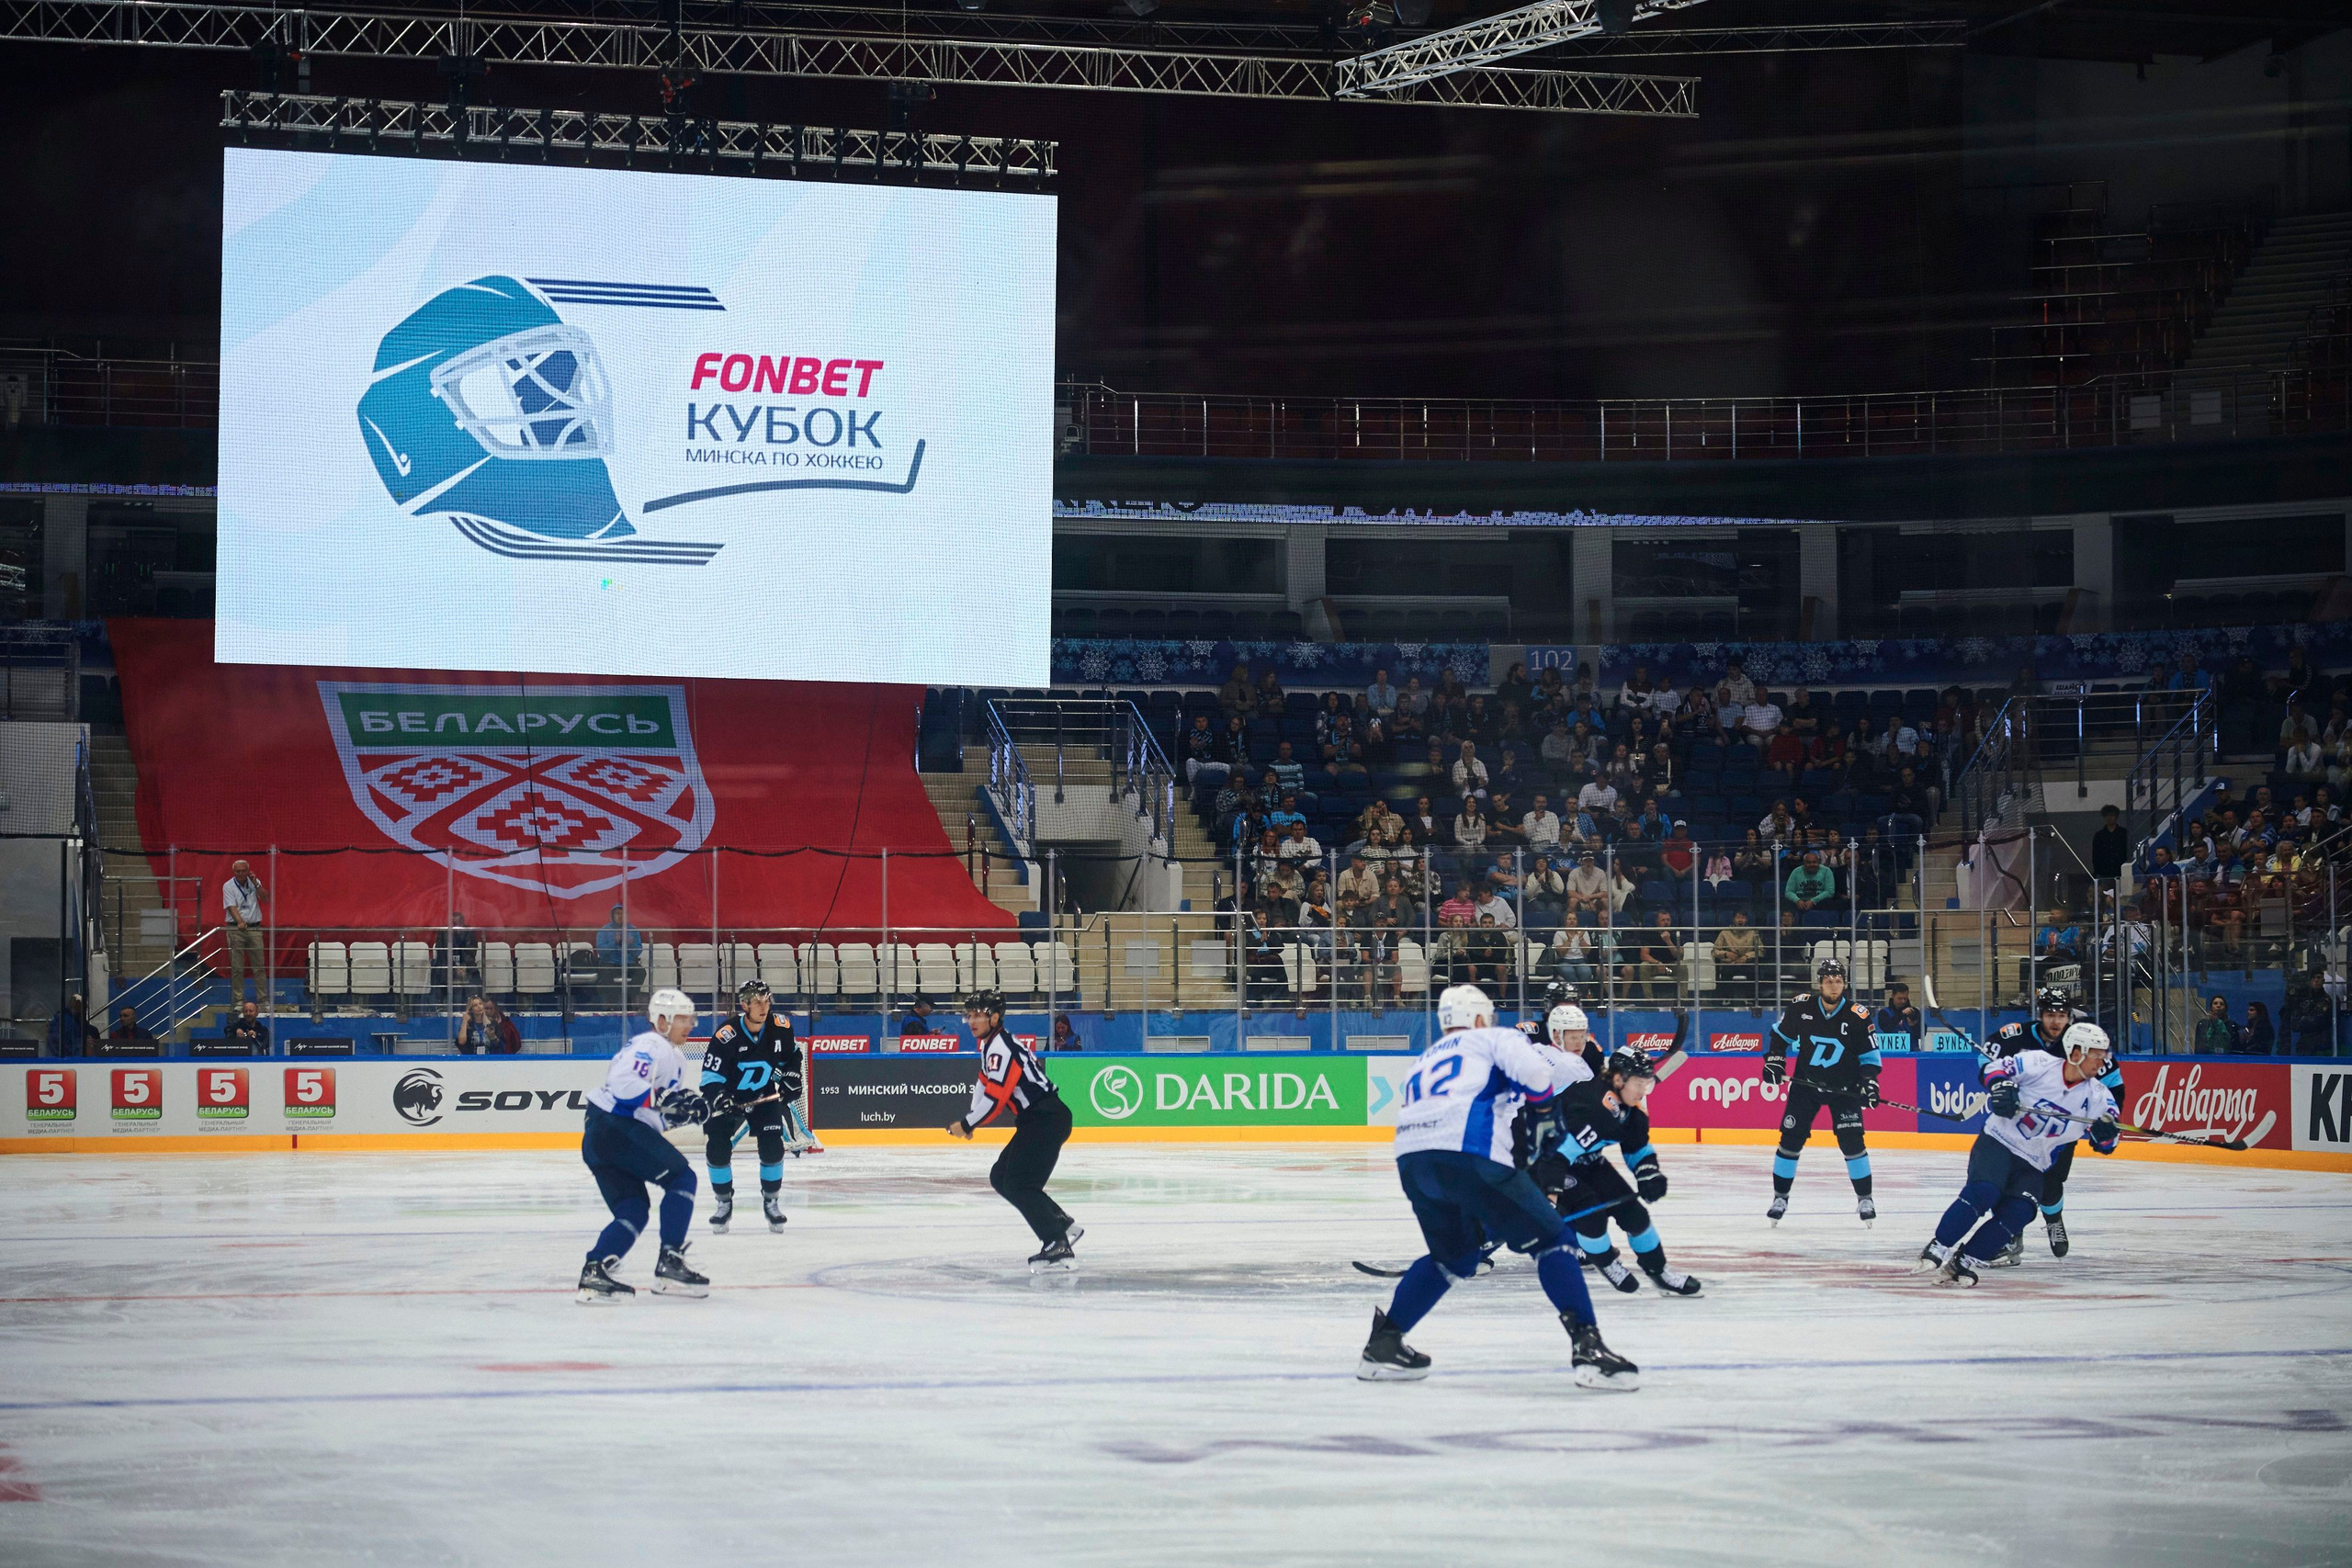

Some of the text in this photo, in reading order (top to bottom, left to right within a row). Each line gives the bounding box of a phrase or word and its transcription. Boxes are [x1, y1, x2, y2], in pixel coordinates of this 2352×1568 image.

[690, 353, 884, 398] FONBET
[687, 402, 883, 448] КУБОК
[685, 448, 883, 470] МИНСКА ПО ХОККЕЮ
[1531, 650, 1573, 671] 102
[359, 710, 660, 735] БЕЛАРУСЬ
[1840, 1021, 1849, 1035] C
[774, 1040, 782, 1053] A
[811, 1039, 867, 1051] FONBET
[901, 1038, 957, 1050] FONBET
[1880, 1036, 1906, 1050] YNEX
[704, 1053, 722, 1072] 33
[39, 1073, 64, 1104] 5
[123, 1073, 150, 1103] 5
[209, 1072, 236, 1102] 5
[297, 1072, 323, 1102] 5
[848, 1083, 907, 1095] МИНСКИЙ
[910, 1082, 967, 1094] ЧАСОВОЙ
[1156, 1073, 1340, 1110] DARIDA
[1689, 1077, 1792, 1109] mpro.
[28, 1109, 74, 1117] БЕЛАРУСЬ
[112, 1108, 160, 1116] БЕЛАРУСЬ
[198, 1107, 247, 1115] БЕЛАРУСЬ
[286, 1107, 334, 1115] БЕЛАРУСЬ
[2081, 1097, 2088, 1110] A
[861, 1111, 896, 1122] luch.by
[1576, 1124, 1598, 1148] 13
